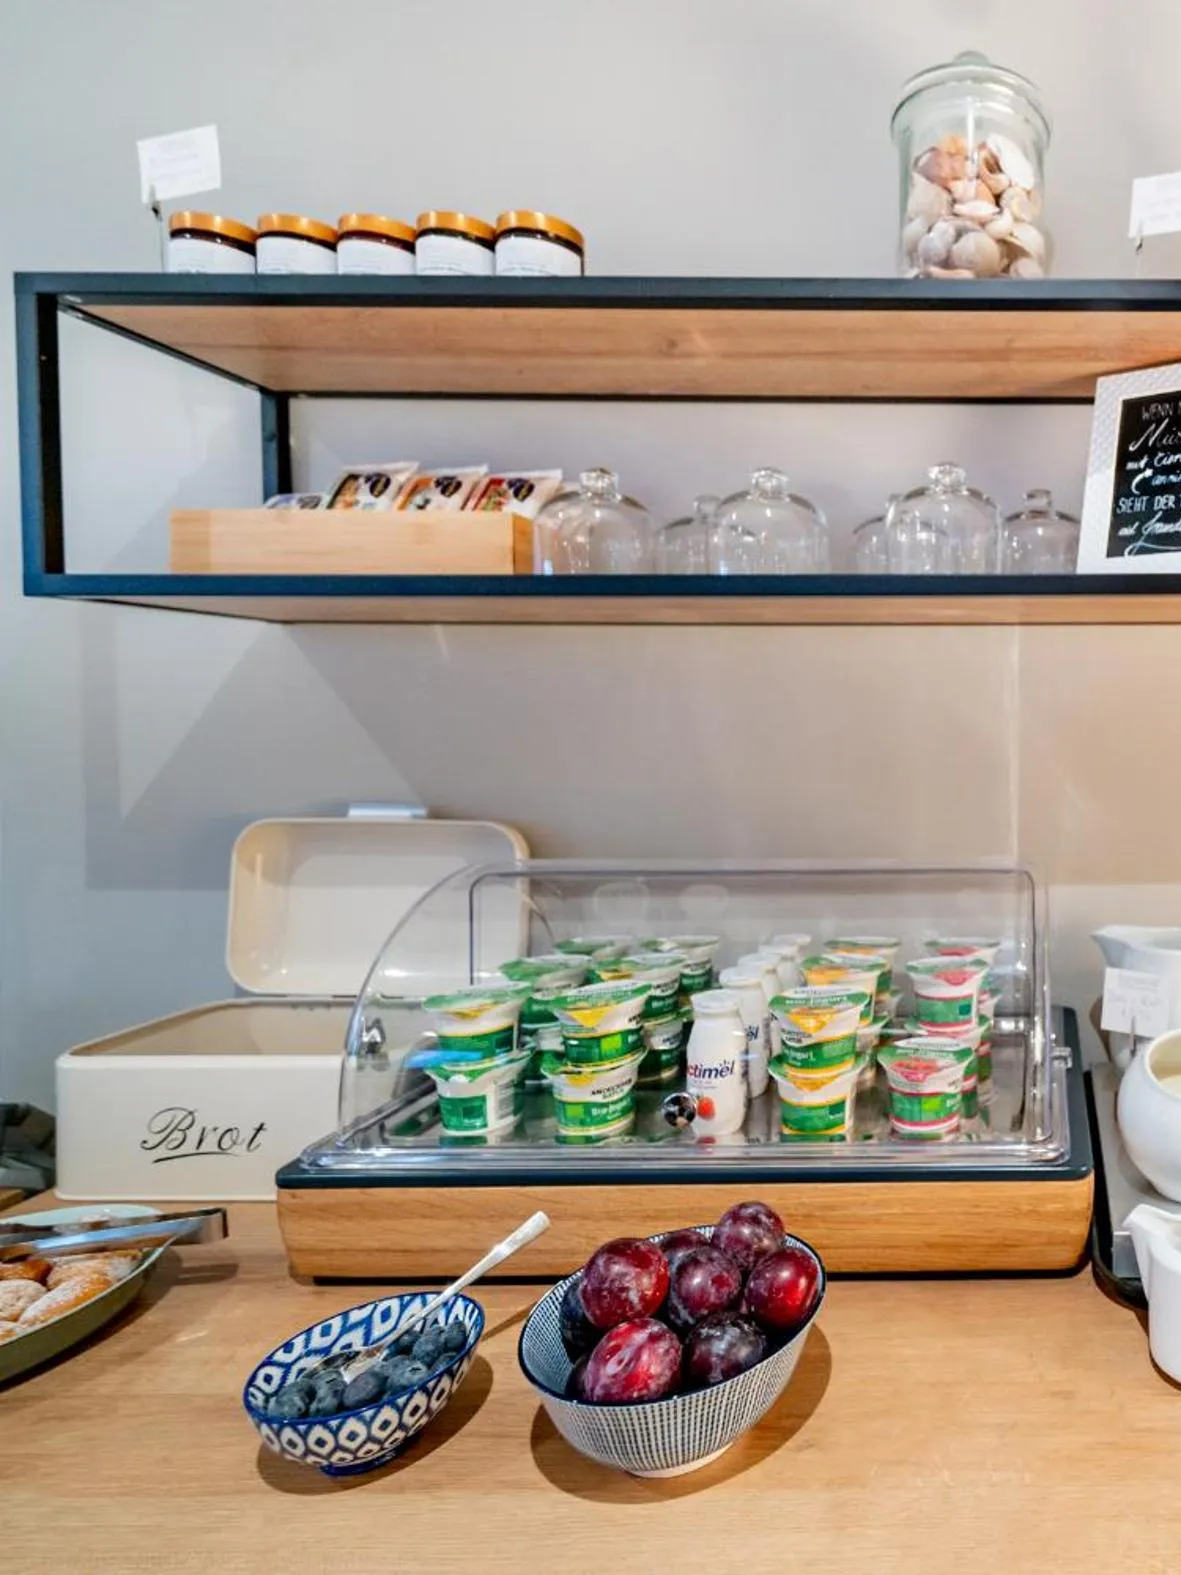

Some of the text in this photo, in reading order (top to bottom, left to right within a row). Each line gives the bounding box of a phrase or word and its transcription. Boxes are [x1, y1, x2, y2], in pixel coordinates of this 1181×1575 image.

[1141, 402, 1173, 420] WENN
[1116, 495, 1149, 514] SIEHT
[1153, 494, 1176, 511] DER
[687, 1059, 735, 1078] ctimel
[140, 1106, 267, 1154] Brot
